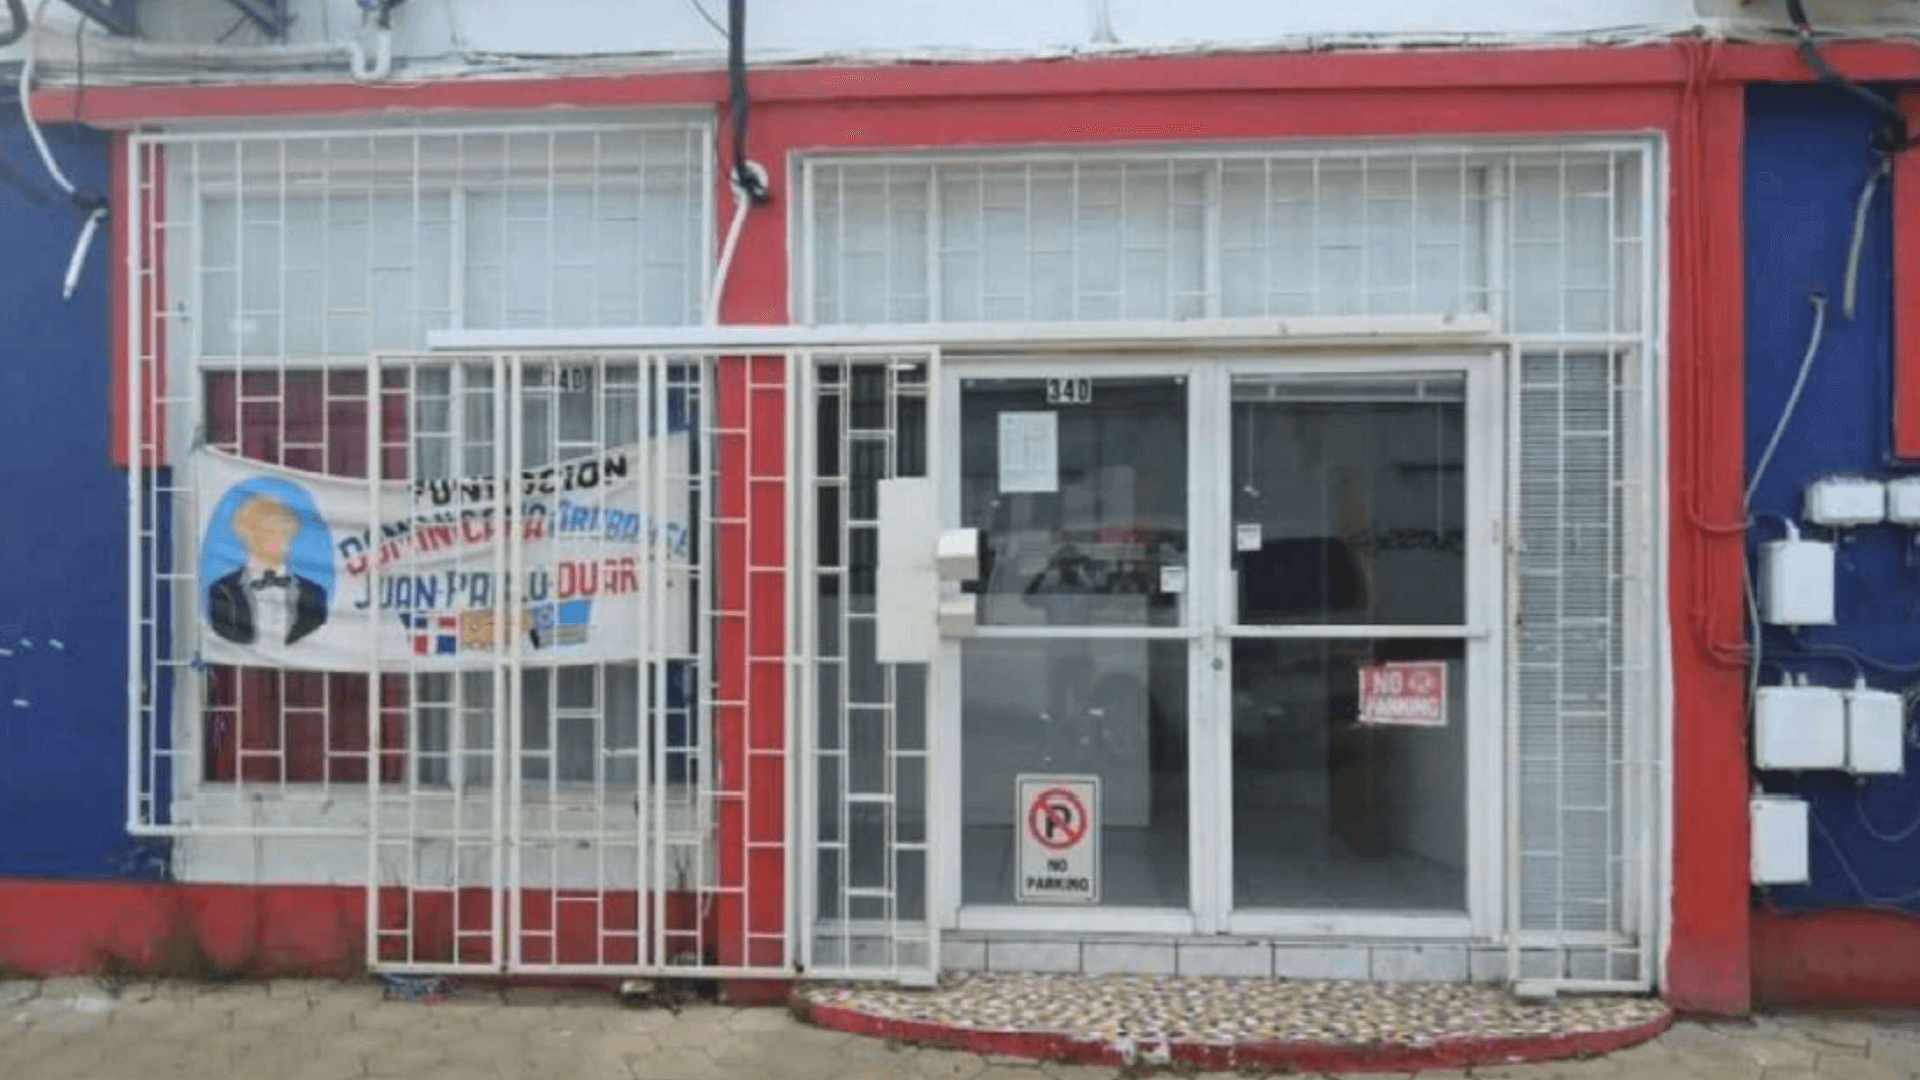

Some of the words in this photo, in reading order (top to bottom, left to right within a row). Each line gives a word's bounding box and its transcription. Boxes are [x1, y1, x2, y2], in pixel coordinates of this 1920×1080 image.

[541, 367, 586, 391] 40
[1048, 379, 1090, 402] 340
[354, 574, 436, 610] JUAN
[445, 571, 548, 606] PAO
[558, 557, 675, 599] DUAR
[1373, 671, 1403, 694] NO
[1047, 859, 1068, 873] NO
[1026, 877, 1089, 892] PARKING
